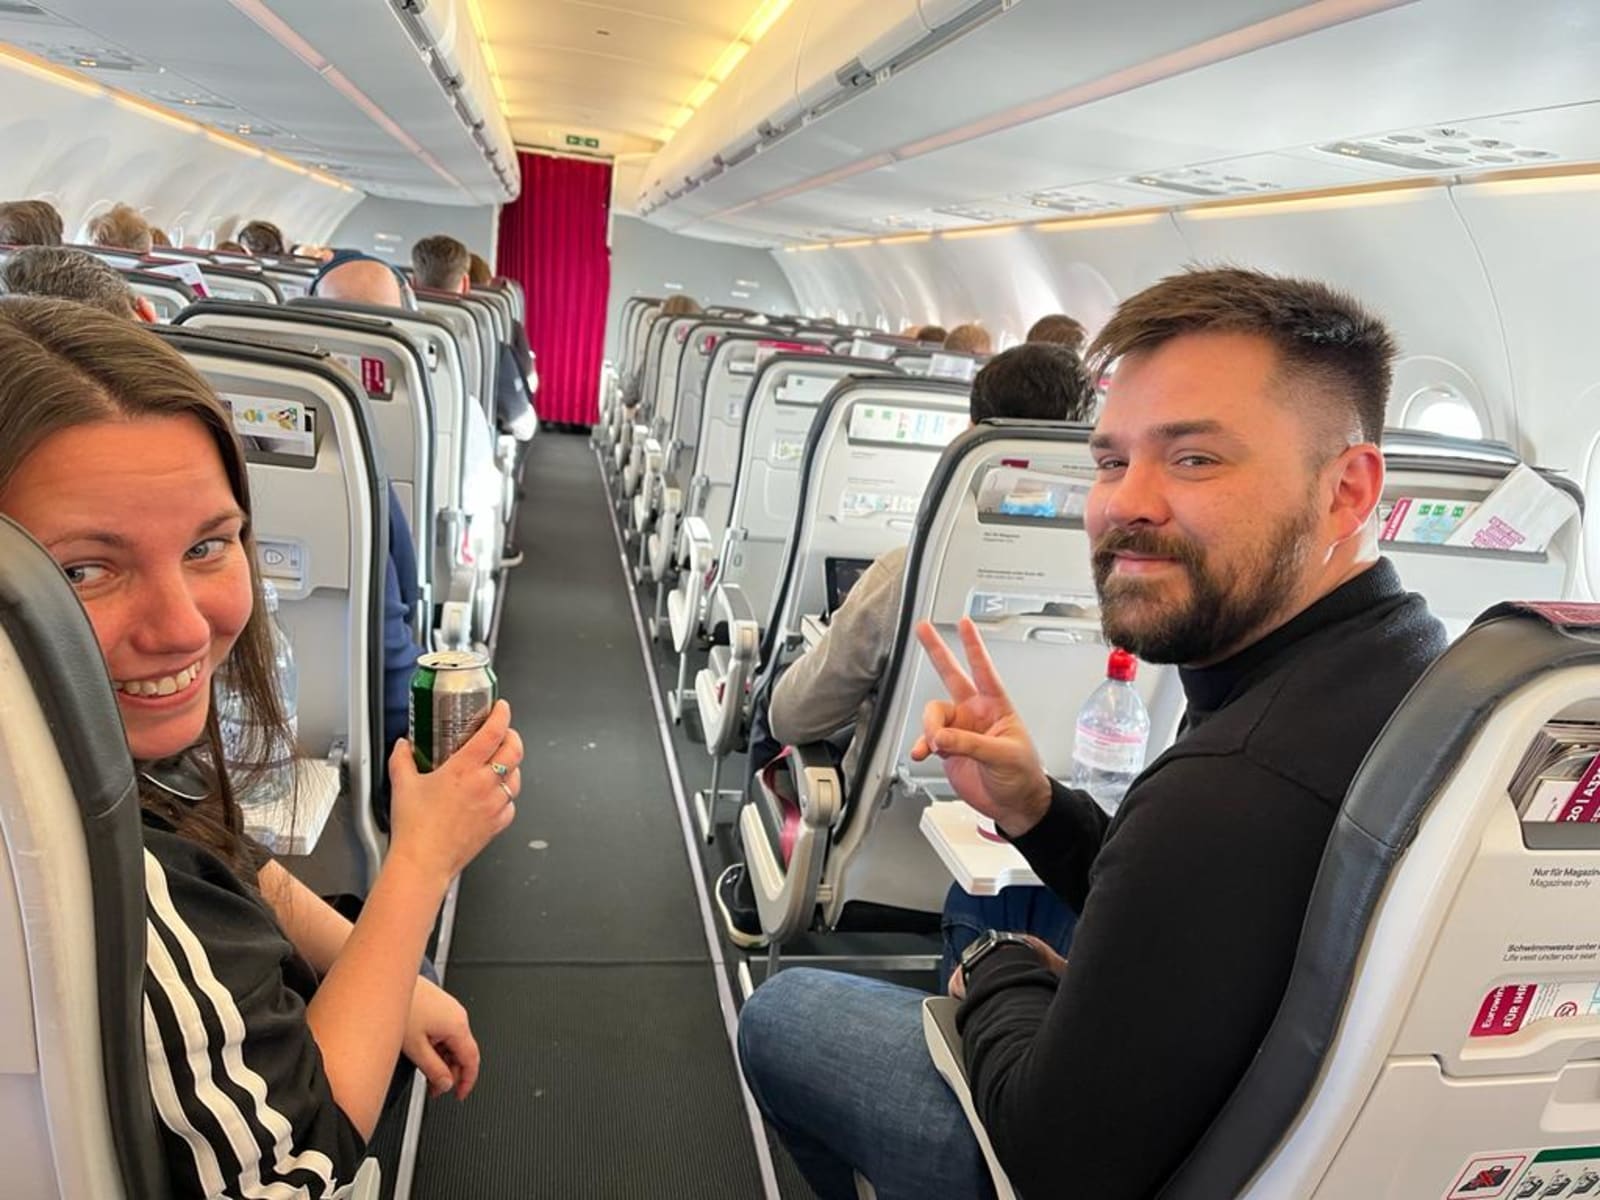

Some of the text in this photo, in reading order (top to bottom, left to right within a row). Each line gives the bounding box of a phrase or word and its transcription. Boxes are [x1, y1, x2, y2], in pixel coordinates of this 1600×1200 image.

[1533, 867, 1550, 876] Nur
[1528, 878, 1591, 888] Magazines only
